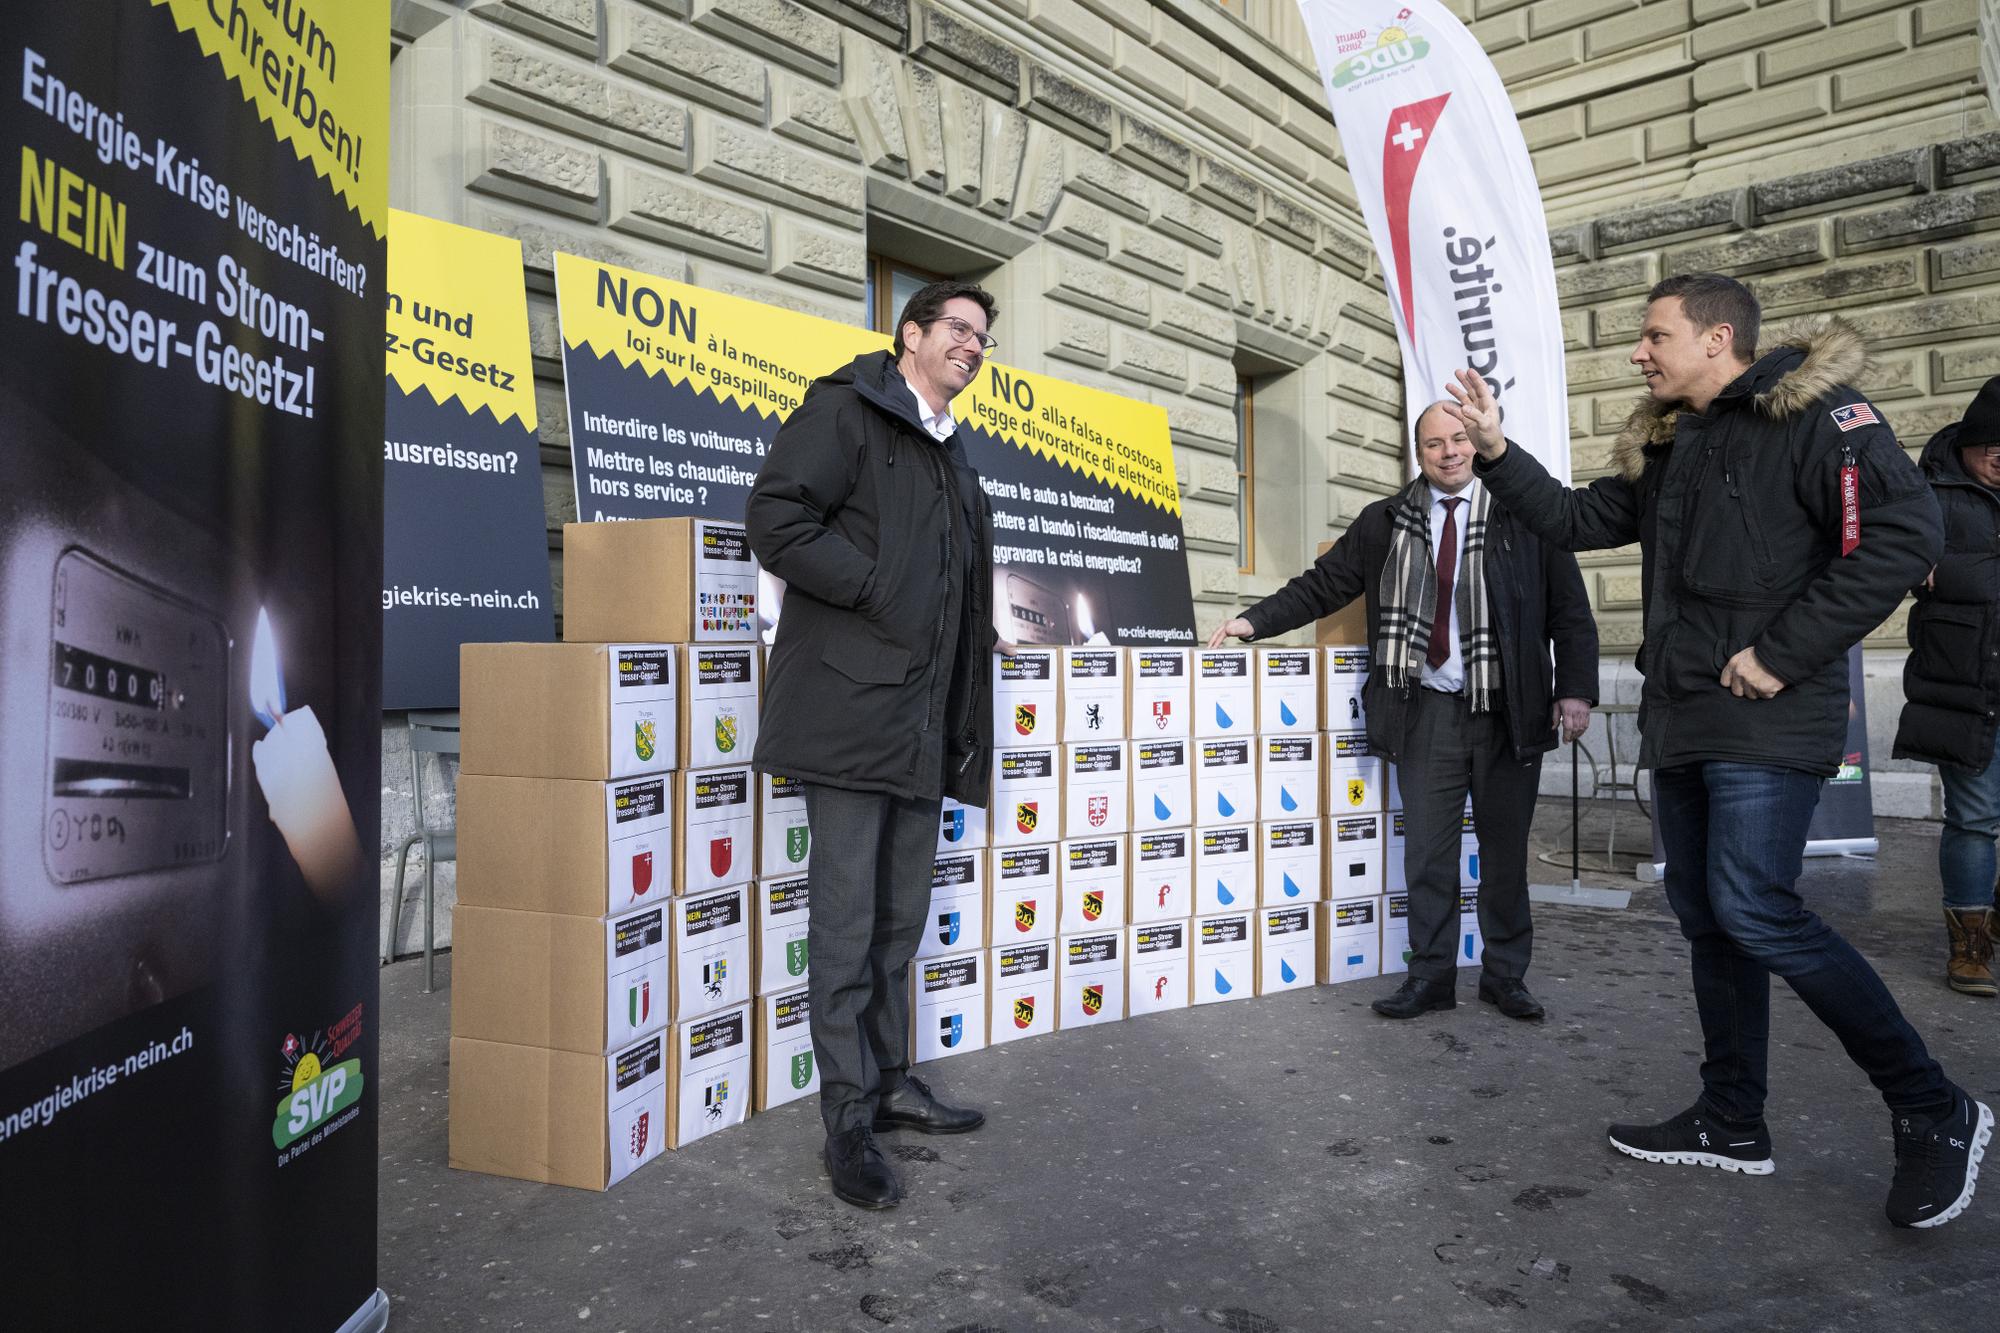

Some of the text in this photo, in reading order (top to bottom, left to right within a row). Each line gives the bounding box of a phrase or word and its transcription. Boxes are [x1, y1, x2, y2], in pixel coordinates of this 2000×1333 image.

[23, 47, 366, 298] Energie-Krise verschärfen?
[20, 146, 324, 352] NEIN zum Strom-
[413, 300, 473, 339] und
[596, 268, 697, 344] NON
[708, 334, 718, 352] à
[722, 339, 737, 361] la
[16, 241, 314, 419] fresser-Gesetz!
[627, 329, 798, 412] loi sur le gaspillage
[991, 366, 1163, 474] NO alla falsa e costosa
[584, 411, 765, 456] Interdire les voitures à
[385, 441, 518, 474] ausreissen?
[973, 394, 1177, 502] legge divoratrice di elettricità
[587, 447, 645, 474] Mettre
[649, 455, 674, 478] les
[589, 473, 707, 506] hors service ?
[1020, 482, 1031, 501] le
[1034, 487, 1058, 506] auto
[1060, 493, 1069, 507] a
[1070, 490, 1115, 514] benzina?
[704, 535, 716, 545] NEIN
[725, 537, 742, 547] Strom-
[1028, 516, 1039, 532] al
[1042, 517, 1075, 538] bando
[1077, 521, 1082, 538] i
[1084, 522, 1148, 547] riscaldamenti
[1150, 535, 1157, 547] a
[1158, 531, 1179, 551] olio?
[704, 545, 741, 555] fresser-Gesetz!
[1046, 546, 1057, 565] la
[1060, 550, 1083, 568] crisi
[1086, 554, 1142, 574] energetica?
[1118, 625, 1193, 642] no-crisi-energetica.ch
[619, 662, 632, 671] NEIN
[642, 662, 660, 670] Strom-
[620, 671, 659, 680] fresser-Gesetz!
[699, 662, 713, 670] NEIN
[723, 661, 741, 669] Strom-
[700, 670, 740, 678] fresser-Gesetz!
[1837, 766, 1856, 779] VP
[696, 785, 709, 795] NEIN
[719, 782, 737, 792] Strom-
[696, 791, 736, 803] fresser-Gesetz!
[616, 797, 629, 808] NEIN
[638, 792, 655, 804] Strom-
[617, 802, 655, 817] fresser-Gesetz!
[687, 911, 700, 922] NEIN
[711, 903, 730, 916] Strom-
[687, 913, 729, 930] fresser-Gesetz!
[1001, 957, 1013, 965] NEIN
[1022, 953, 1040, 962] Strom-
[1001, 961, 1039, 972] fresser-Gesetz!
[925, 971, 938, 980] NEIN
[948, 967, 967, 976] Strom-
[925, 975, 966, 987] fresser-Gesetz!
[691, 1033, 704, 1045] NEIN
[714, 1024, 733, 1037] Strom-
[691, 1033, 732, 1053] fresser-Gesetz!
[288, 1067, 346, 1135] SVP
[278, 1107, 360, 1168] Die Partei des Mittelstandes
